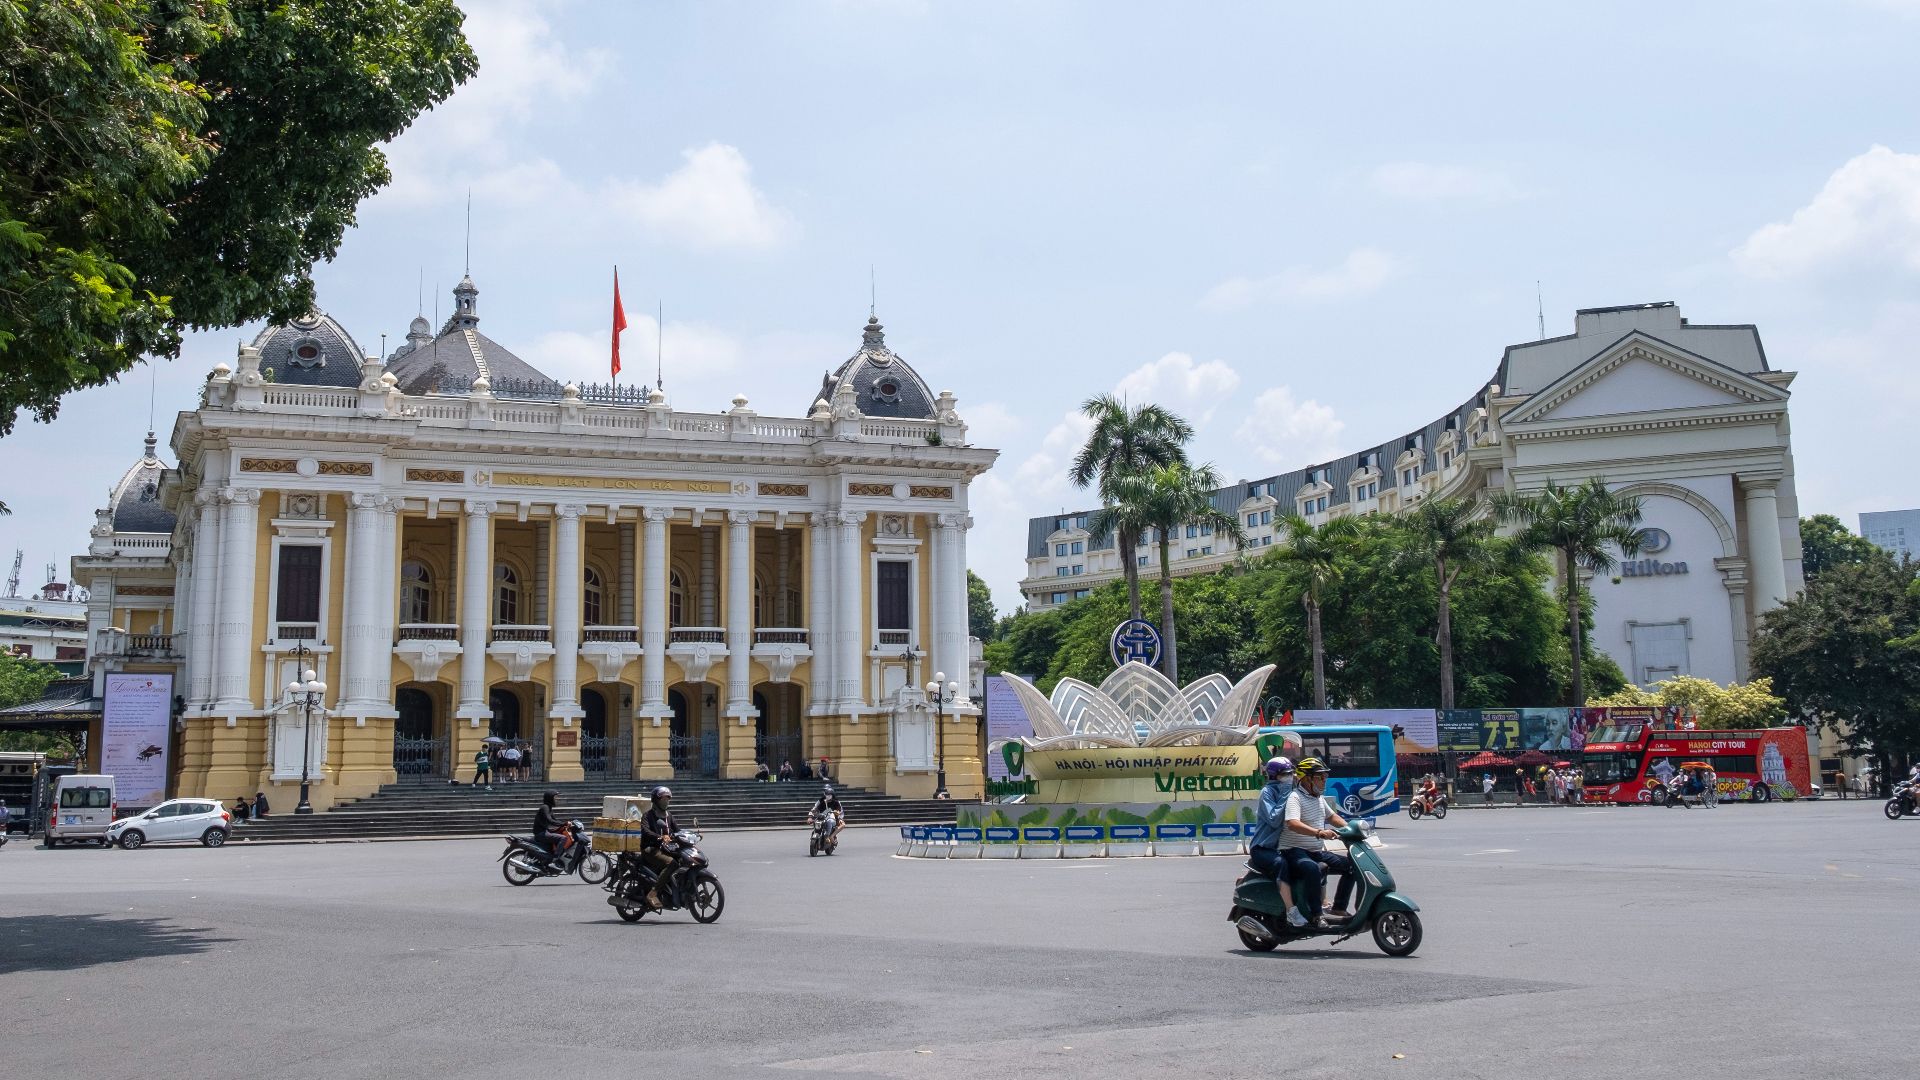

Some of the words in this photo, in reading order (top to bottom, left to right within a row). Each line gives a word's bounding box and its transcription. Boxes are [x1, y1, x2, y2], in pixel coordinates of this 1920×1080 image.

[1621, 559, 1689, 577] Hilton
[1688, 741, 1711, 749] HANOI
[1712, 741, 1727, 749] CITY
[1728, 741, 1746, 749] TOUR
[1055, 758, 1071, 770] HÀ
[1073, 757, 1095, 772] NỘI
[1106, 757, 1129, 772] HỘI
[1133, 756, 1171, 774] NHẬP
[1175, 754, 1208, 768] PHÁT
[1209, 752, 1239, 767] TRIỂN
